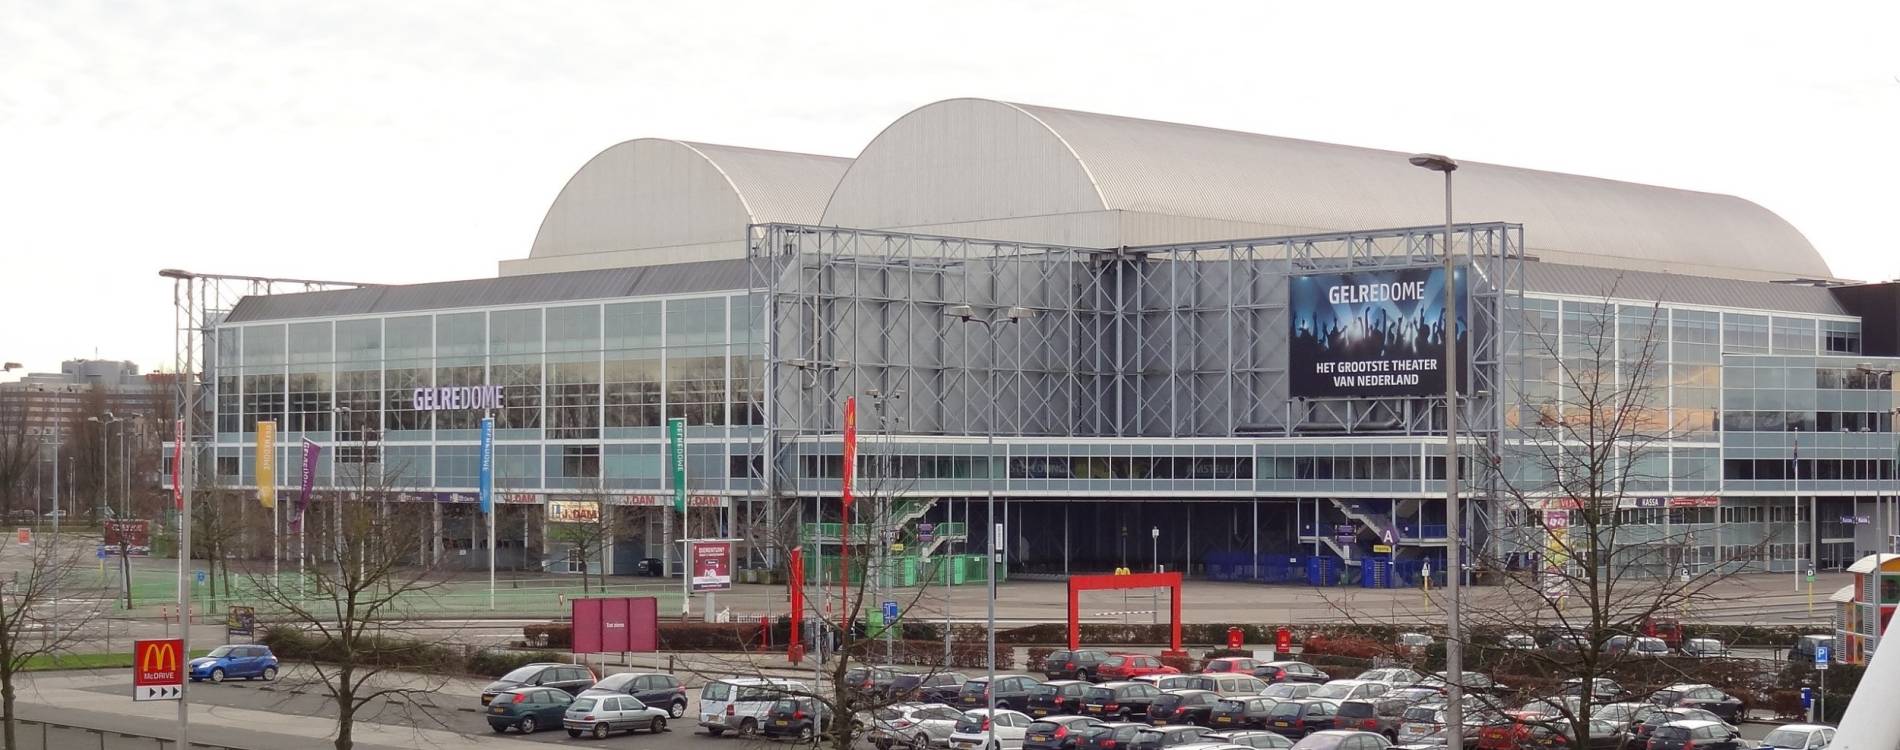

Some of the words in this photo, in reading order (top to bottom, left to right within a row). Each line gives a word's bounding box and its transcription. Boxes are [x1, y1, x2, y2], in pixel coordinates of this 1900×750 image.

[1328, 281, 1425, 305] GELREDOME
[1316, 361, 1336, 374] HET
[1338, 361, 1389, 373] GROOTSTE
[1392, 359, 1438, 371] THEATER
[1333, 376, 1355, 387] VAN
[1357, 374, 1419, 387] NEDERLAND
[413, 386, 504, 411] GELREDOME
[624, 495, 656, 505] J.DAM
[1641, 498, 1659, 506] KASSA
[1383, 530, 1393, 543] A
[1818, 648, 1825, 658] P
[143, 671, 174, 680] McDRIVE
